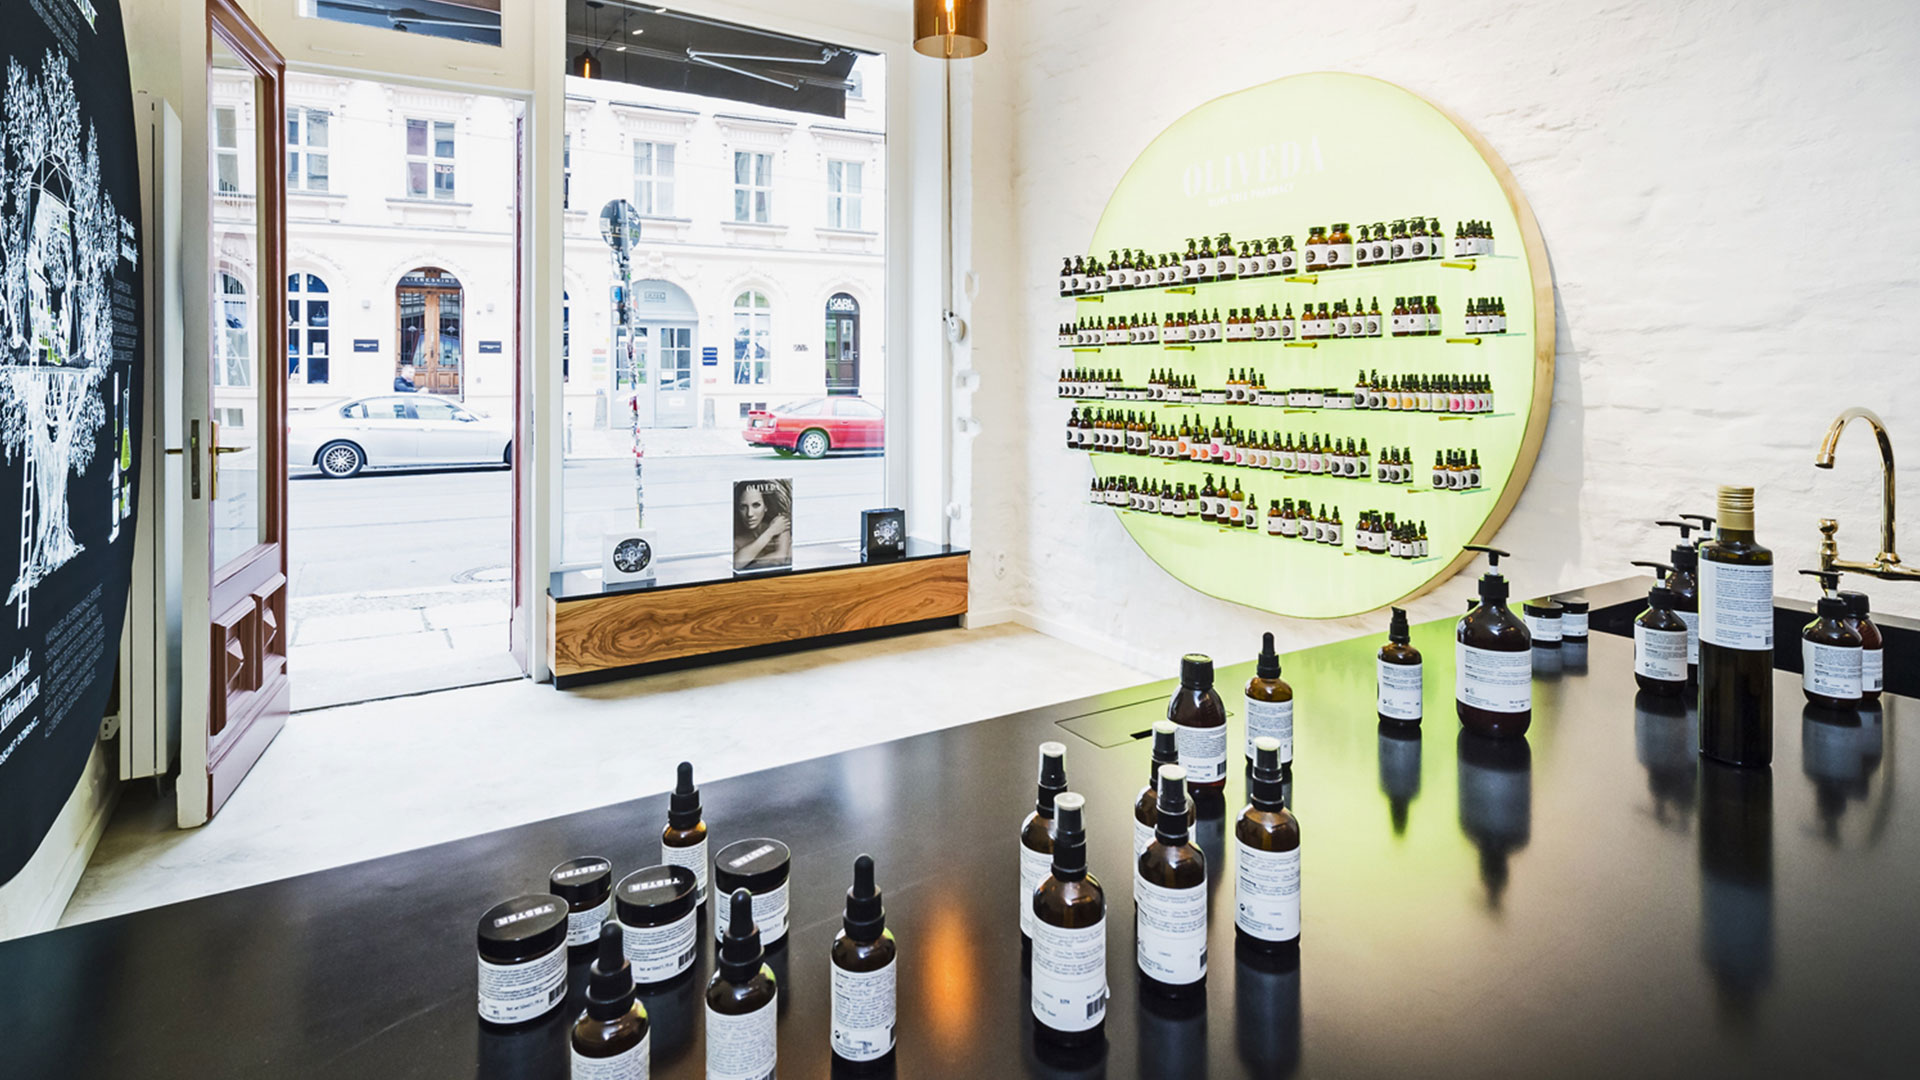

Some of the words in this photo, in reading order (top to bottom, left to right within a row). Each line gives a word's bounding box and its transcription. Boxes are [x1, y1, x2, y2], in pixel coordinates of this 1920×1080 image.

[1183, 134, 1325, 198] OLIVEDA
[556, 864, 606, 879] TESTER
[631, 877, 680, 891] TESTER
[497, 904, 553, 926] TESTER
